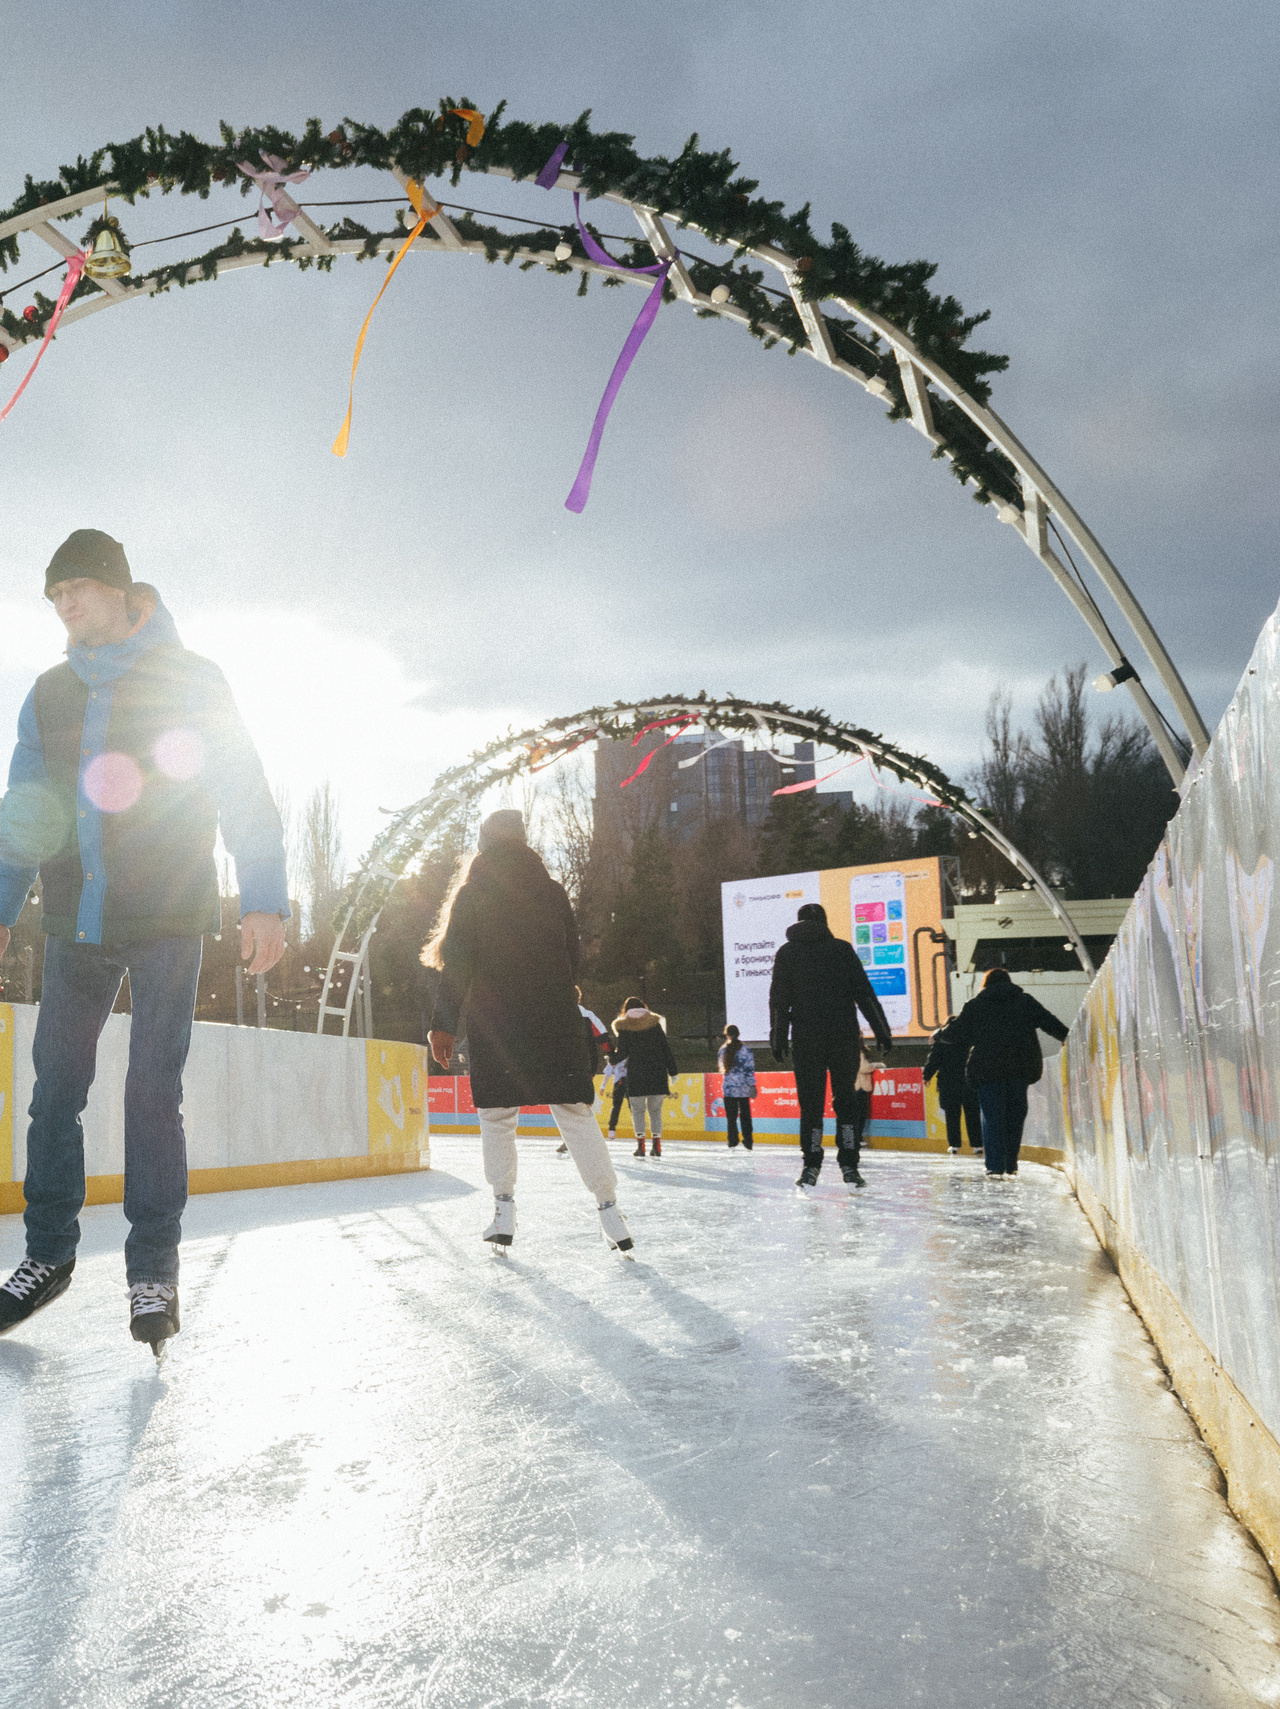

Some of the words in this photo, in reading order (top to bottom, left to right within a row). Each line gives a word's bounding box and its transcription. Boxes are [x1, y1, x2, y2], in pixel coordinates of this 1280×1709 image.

[734, 940, 776, 952] Покупайте
[735, 957, 741, 965] и
[741, 955, 776, 965] брониру
